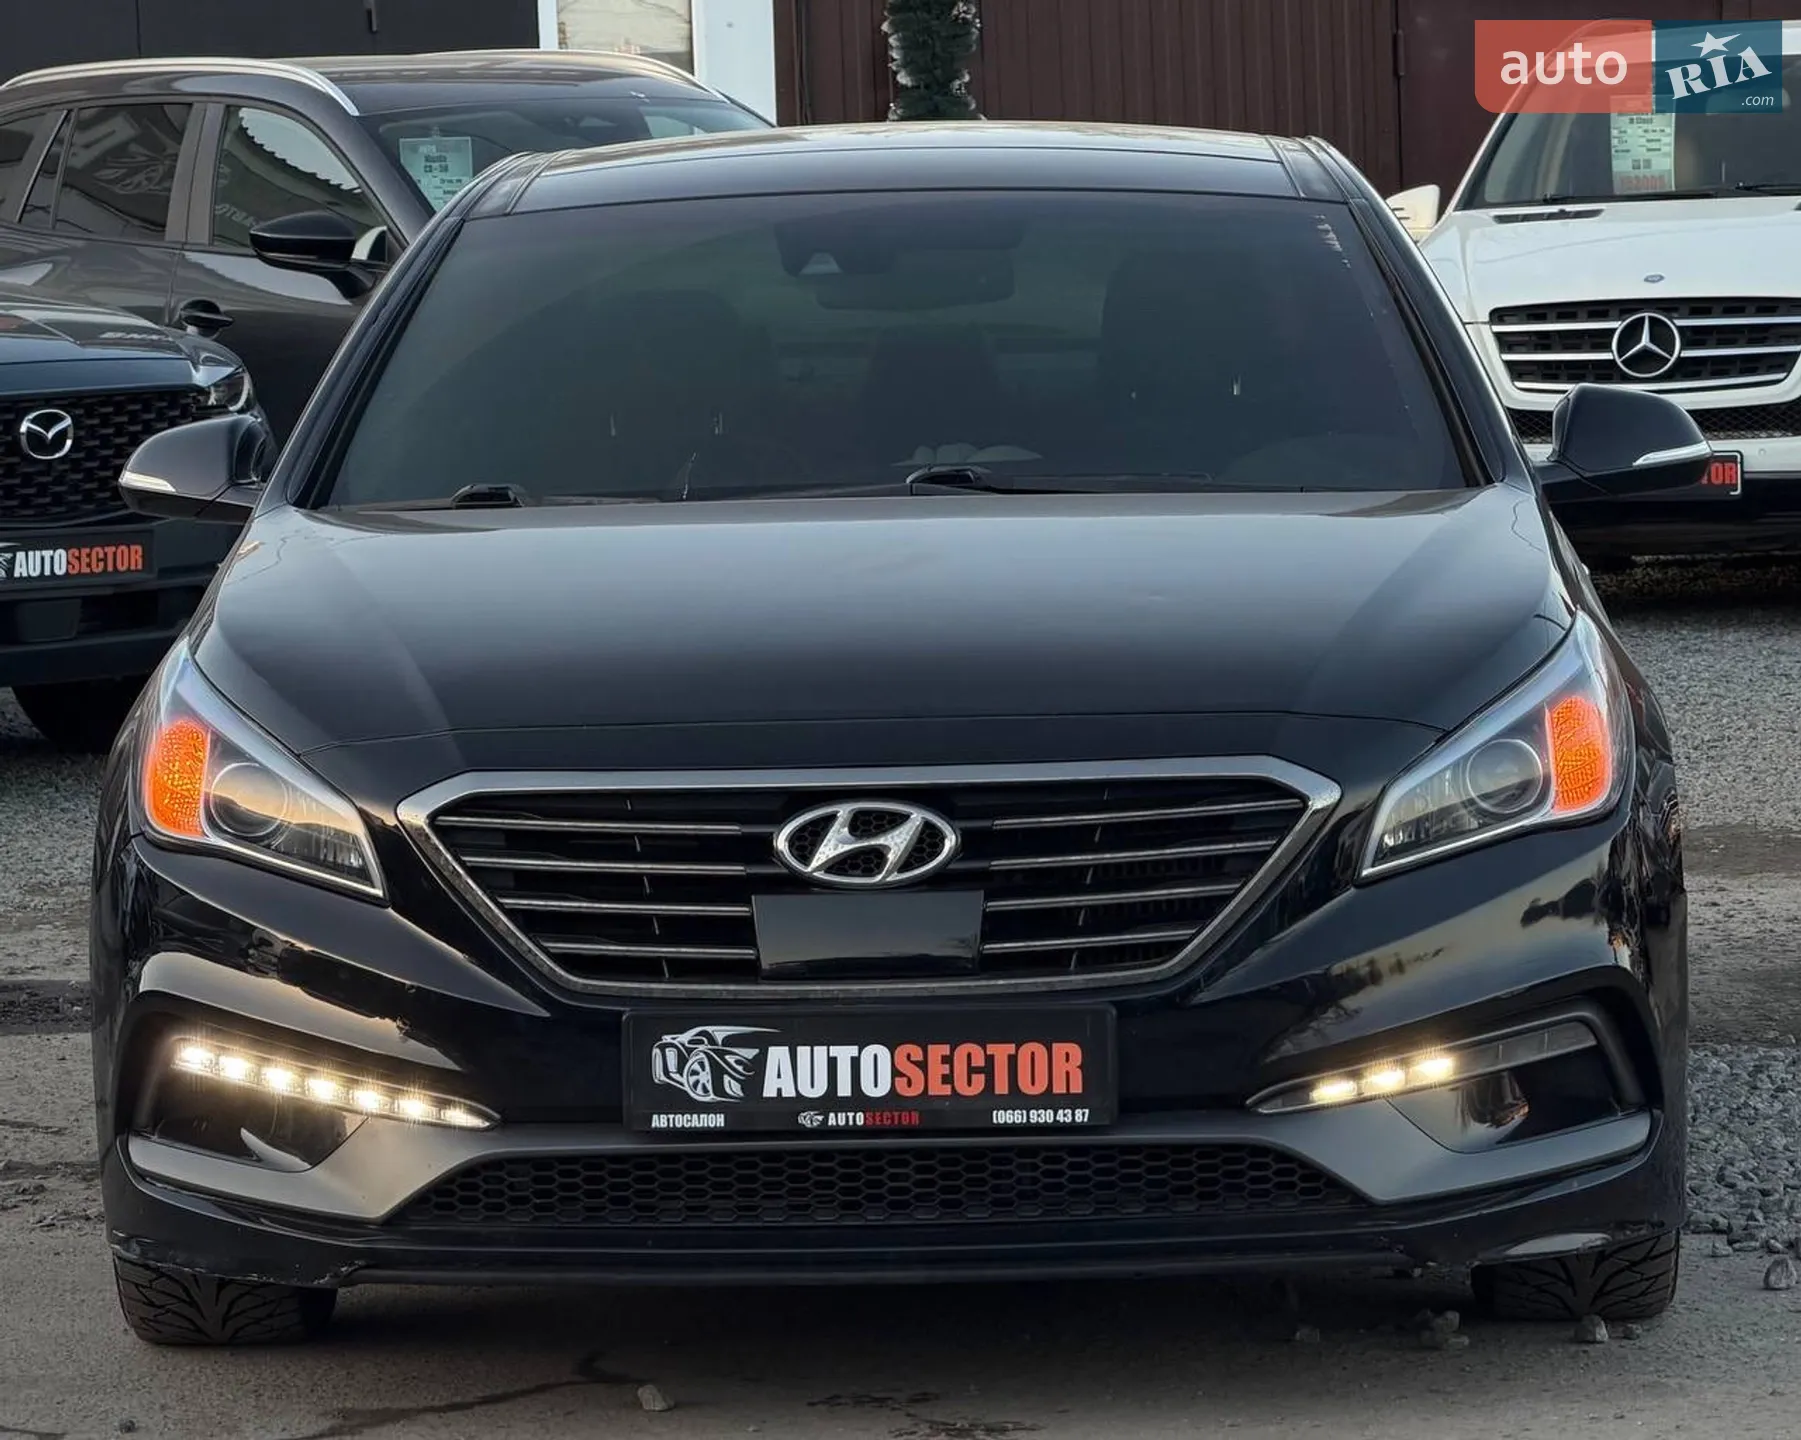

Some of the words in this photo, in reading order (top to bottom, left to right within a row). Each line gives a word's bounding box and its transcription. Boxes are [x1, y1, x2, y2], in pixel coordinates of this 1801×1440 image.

[14, 544, 143, 578] AUTOSECTOR
[762, 1042, 1083, 1098] AUTOSECTOR
[651, 1113, 725, 1128] АВТОСАЛОН
[827, 1110, 920, 1127] AUTOSECTOR
[992, 1109, 1027, 1124] (066)
[1029, 1108, 1054, 1124] 930
[1056, 1108, 1072, 1123] 43
[1074, 1108, 1090, 1123] 87
